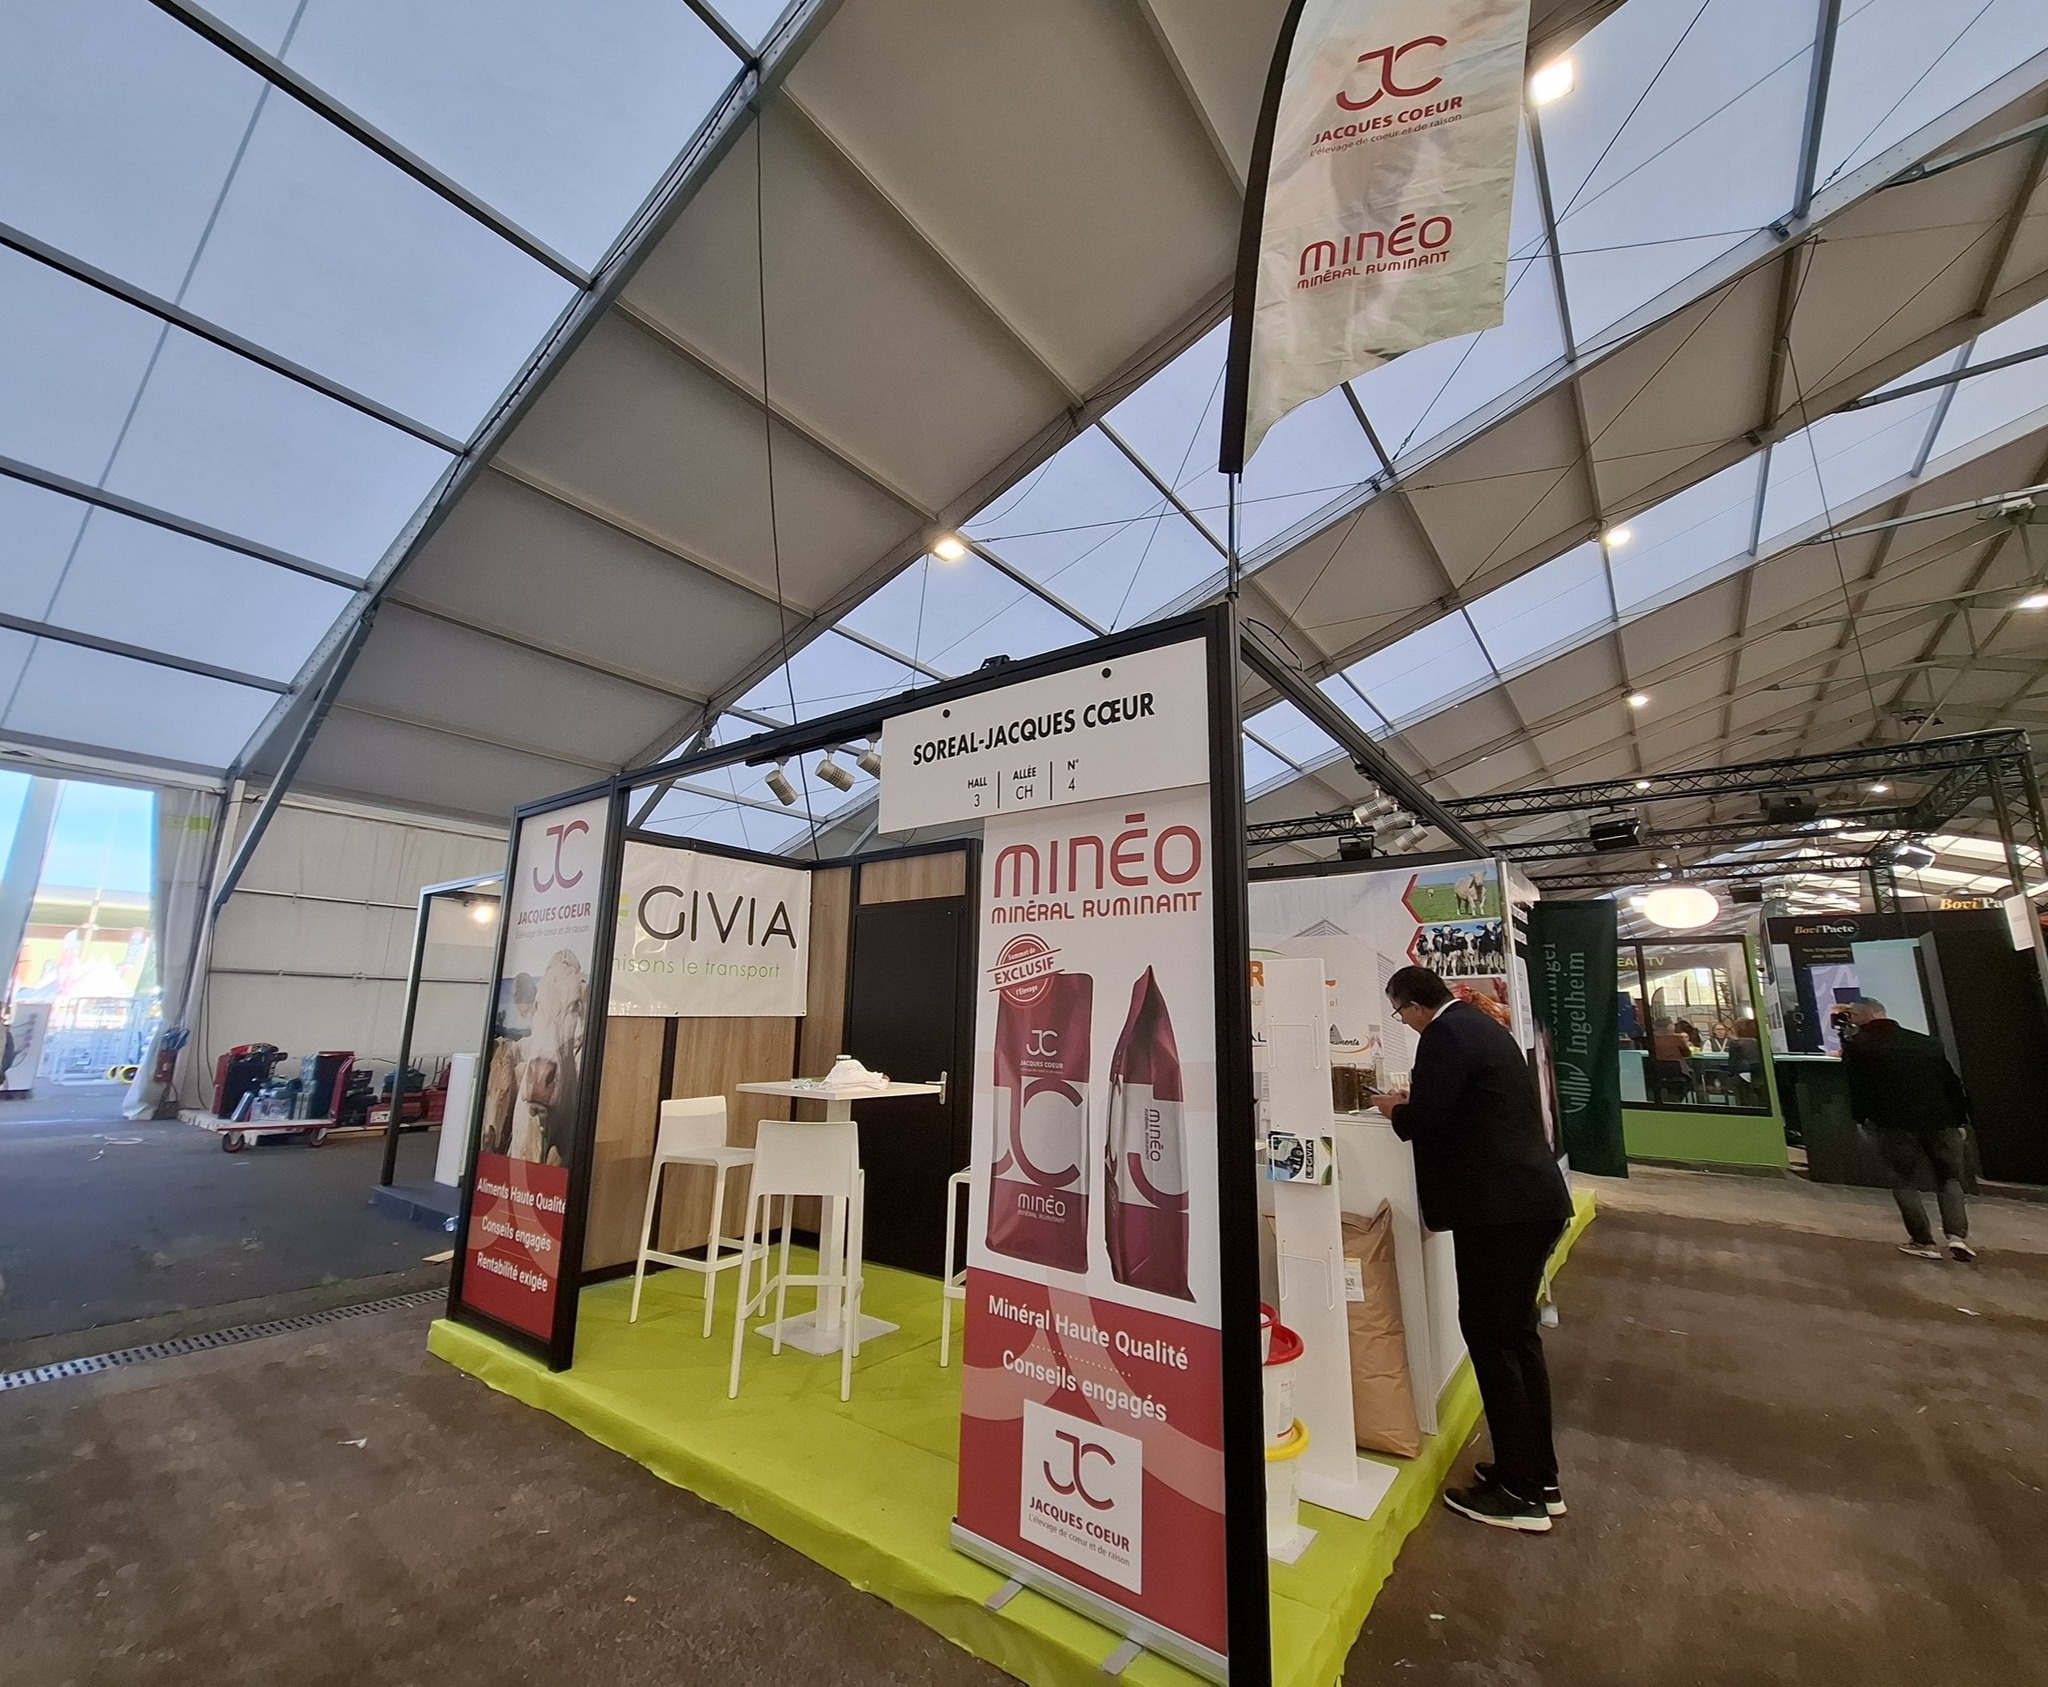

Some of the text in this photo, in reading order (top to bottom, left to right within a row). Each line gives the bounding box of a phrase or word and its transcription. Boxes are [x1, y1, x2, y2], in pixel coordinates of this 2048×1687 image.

[1310, 113, 1462, 157] L'élevage de coeur et de raison
[1312, 96, 1463, 146] JACQUES COEUR
[1365, 250, 1450, 275] RUMINANT
[912, 692, 1155, 766] SOREAL-JACQUES CŒUR
[967, 758, 1080, 790] HALL ALLÉE N°
[973, 777, 1076, 808] 3 CH 4
[518, 902, 592, 925] JACQUES COEUR
[638, 885, 797, 949] GIVIA
[1082, 892, 1203, 918] RUMINANT
[682, 958, 698, 974] le
[705, 959, 780, 980] transport
[994, 956, 1055, 985] EXCLUSIF
[1563, 952, 1592, 1055] Ingelheim
[477, 1178, 509, 1200] Aliments
[511, 1187, 535, 1207] Haute
[482, 1216, 552, 1252] Conseils engagés
[477, 1252, 548, 1292] Rentabilité exigée
[988, 1295, 1189, 1371] Minéral Haute Qualité
[1002, 1350, 1168, 1423] Conseils engagés
[1029, 1496, 1130, 1553] JACQUES COEUR
[1059, 1528, 1067, 1537] de
[1068, 1534, 1088, 1547] coeur
[1089, 1542, 1096, 1551] et
[1098, 1546, 1107, 1556] de
[1108, 1551, 1130, 1567] raison
